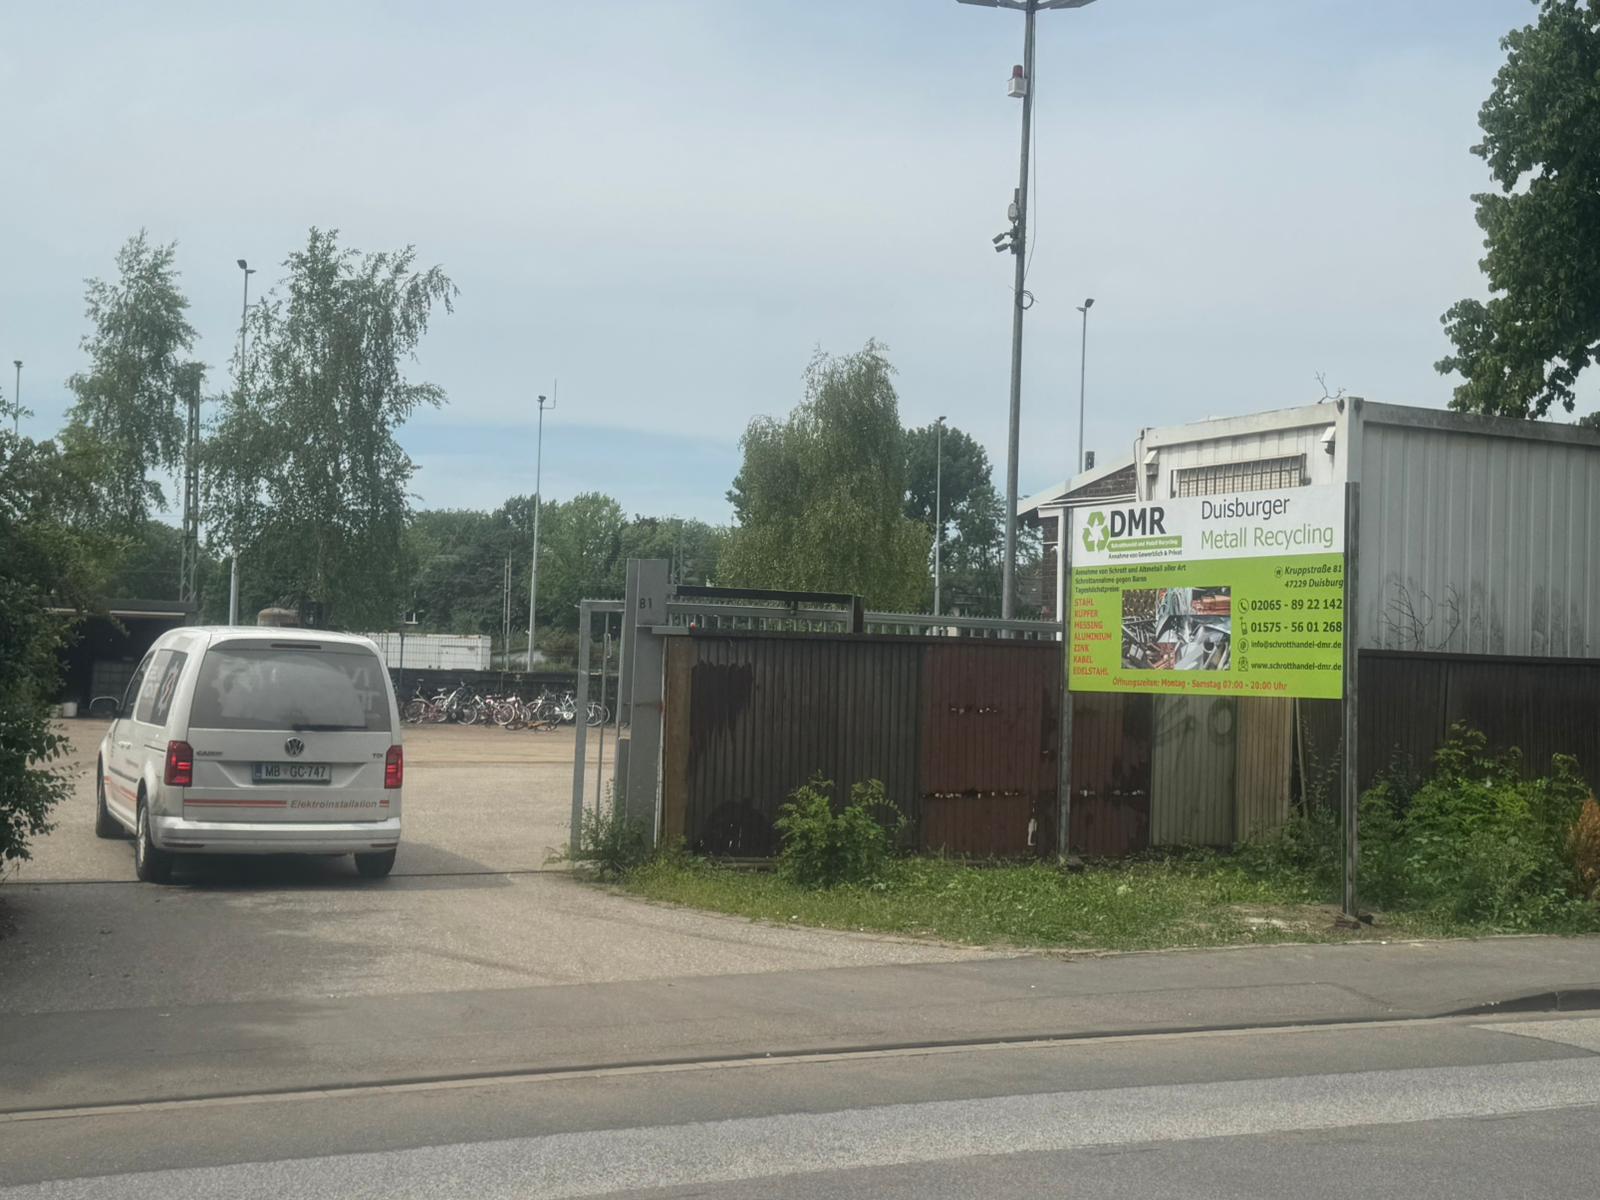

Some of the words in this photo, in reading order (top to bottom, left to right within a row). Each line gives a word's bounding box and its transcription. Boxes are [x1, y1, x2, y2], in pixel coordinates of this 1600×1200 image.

[1201, 498, 1290, 521] Duisburger
[1110, 507, 1166, 538] DMR
[1201, 527, 1247, 550] Metall
[1254, 523, 1333, 549] Recycling
[1284, 564, 1331, 576] Kruppstraße
[1332, 564, 1342, 573] 81
[1284, 579, 1307, 588] 47229
[1309, 577, 1344, 589] Duisburg
[639, 598, 652, 609] 81
[1074, 598, 1094, 606] STAHL
[1251, 599, 1282, 611] 02065
[1291, 599, 1304, 610] 89
[1307, 599, 1320, 610] 22
[1322, 598, 1342, 610] 142
[1074, 610, 1098, 618] KUPFER
[1074, 621, 1104, 629] MESSING
[1250, 621, 1281, 632] 01575
[1291, 621, 1304, 632] 56
[1306, 621, 1319, 632] 01
[1322, 621, 1342, 632] 268
[1074, 632, 1112, 641] ALUMINIUM
[1073, 644, 1089, 653] ZINK
[1073, 655, 1093, 664] KABEL
[1073, 666, 1109, 675] EDELSTAHL
[1251, 661, 1342, 671] www.schrotthandel-dmr.de
[1161, 679, 1186, 689] Montag
[1191, 680, 1221, 690] Samstag
[1222, 680, 1243, 689] 07:00
[1250, 681, 1272, 690] 20:00
[1273, 682, 1287, 691] Uhr
[265, 765, 281, 777] MB
[290, 799, 378, 809] Elektroinstallation
